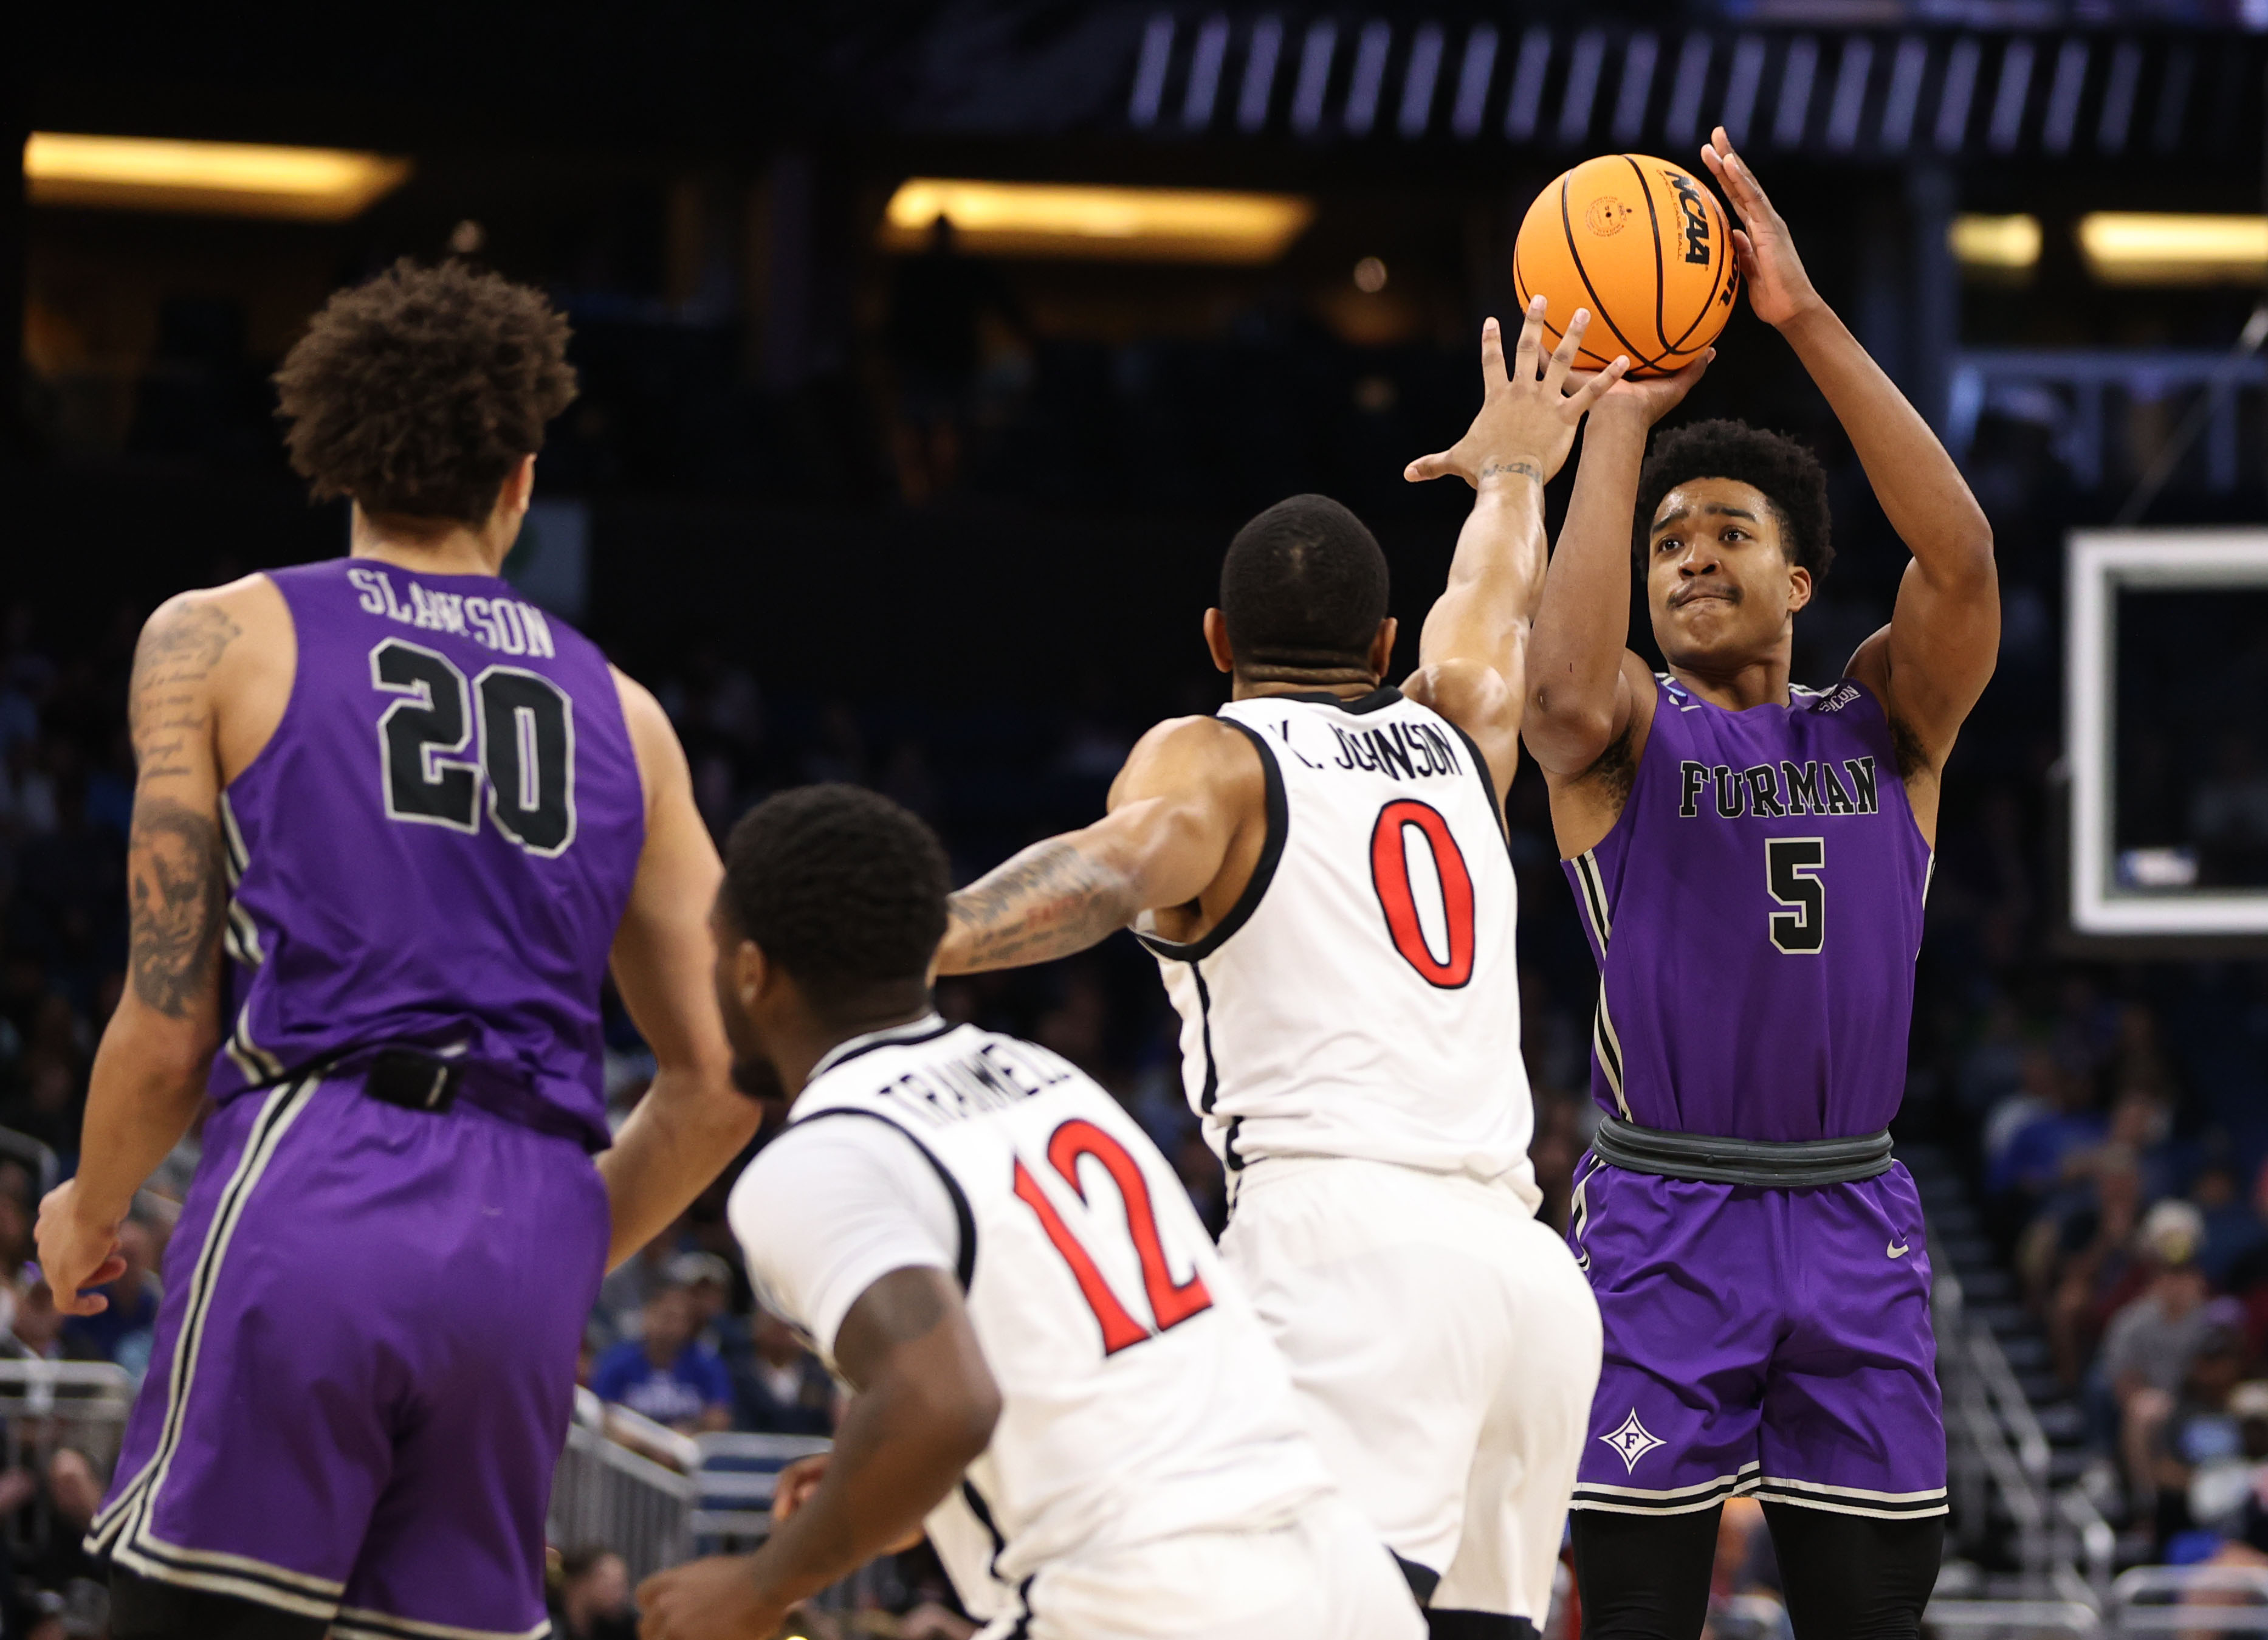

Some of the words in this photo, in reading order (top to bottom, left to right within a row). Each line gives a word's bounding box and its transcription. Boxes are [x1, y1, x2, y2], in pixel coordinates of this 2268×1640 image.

[1664, 171, 1710, 265] NCAA
[348, 568, 555, 659] SLAWSON
[368, 636, 577, 859] 20
[1679, 756, 1878, 819] FURMAN
[1369, 798, 1475, 990] 0
[1765, 836, 1825, 955] 5
[1012, 1117, 1214, 1358] 12
[1624, 1432, 1640, 1450] F
